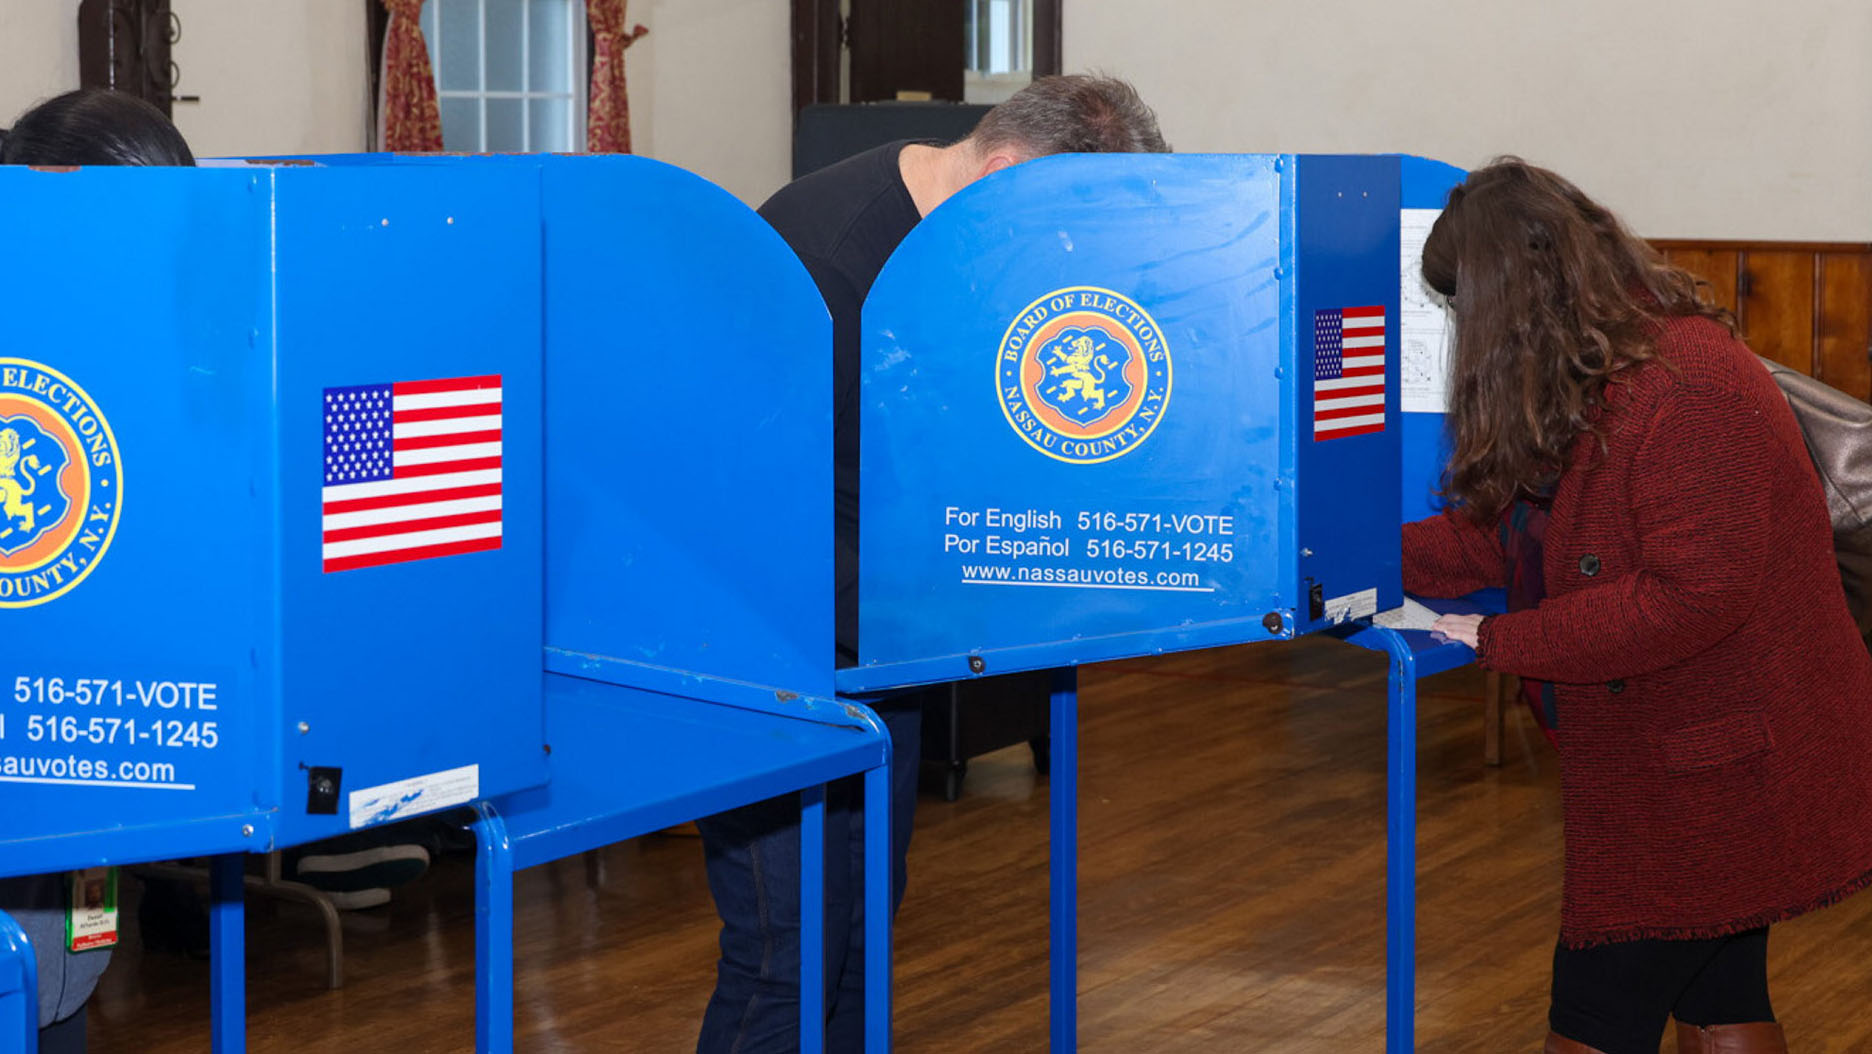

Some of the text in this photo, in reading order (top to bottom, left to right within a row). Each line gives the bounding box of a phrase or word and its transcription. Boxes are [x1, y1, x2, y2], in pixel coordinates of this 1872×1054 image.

[1004, 293, 1164, 362] BOARD OF ELECTIONS
[3, 367, 111, 467] ELECTIONS
[1005, 385, 1164, 457] NASSAU COUNTY, N.Y.
[79, 504, 111, 552] N.Y.
[945, 506, 1233, 535] For English 516-571-VOTE
[944, 534, 1233, 562] Por Español 516-571-1245
[961, 564, 1200, 587] www.nassauvotes.com
[14, 676, 218, 710] 516-571-VOTE
[27, 715, 218, 748] 516-571-1245
[0, 755, 175, 782] auvotes.com
